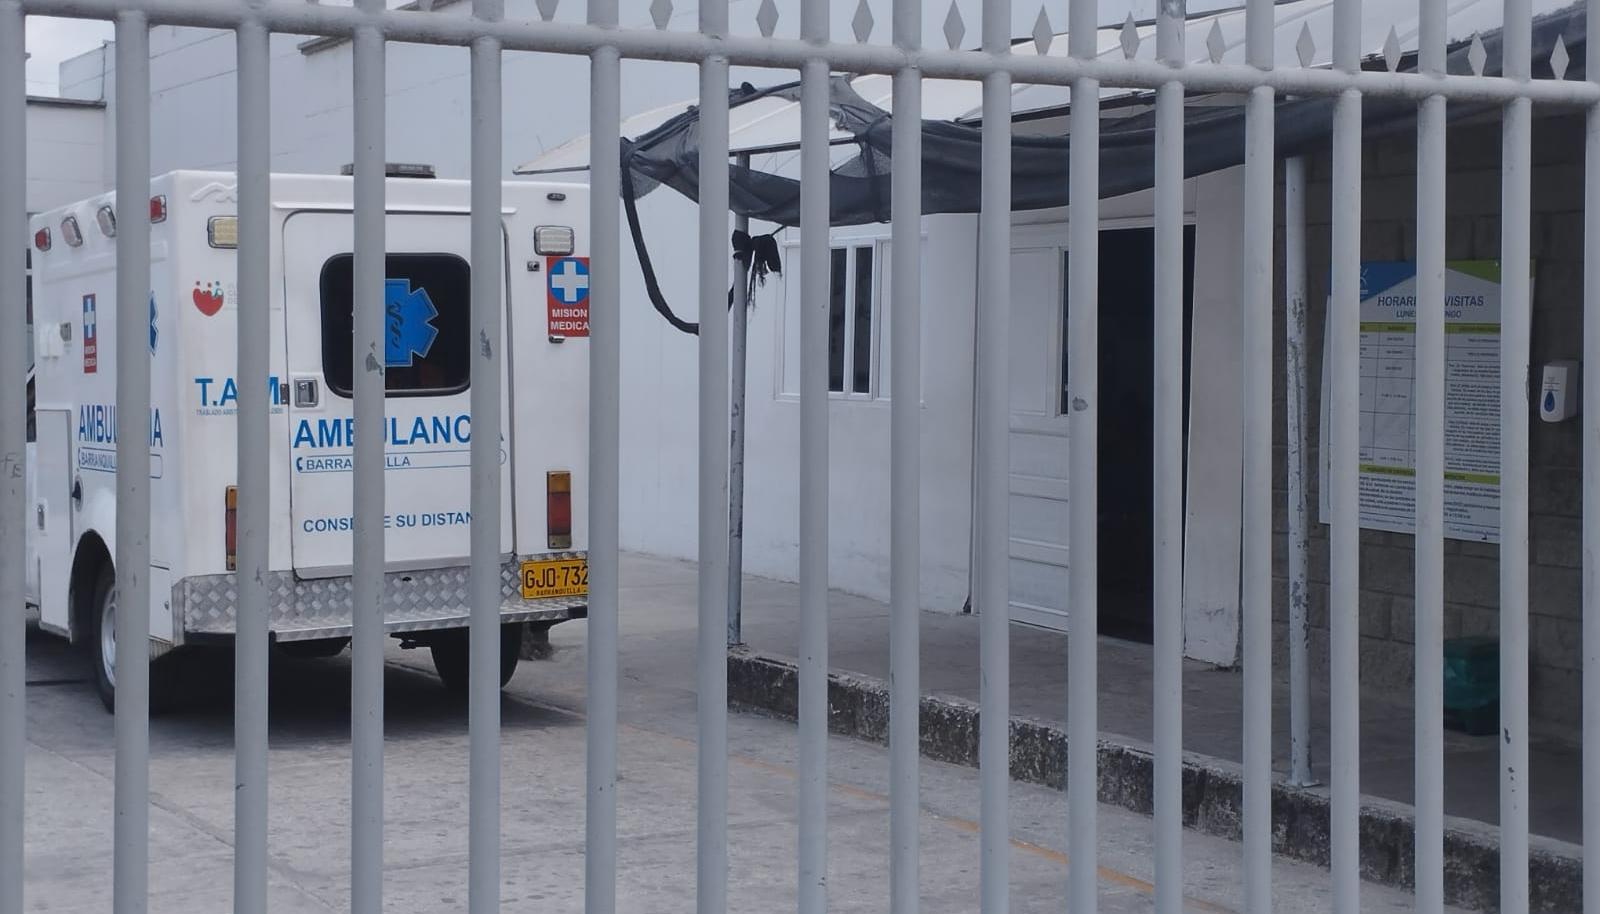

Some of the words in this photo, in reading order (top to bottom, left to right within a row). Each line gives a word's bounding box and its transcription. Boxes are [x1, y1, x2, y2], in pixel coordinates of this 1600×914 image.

[1445, 296, 1484, 306] VISITAS
[551, 308, 588, 318] MISION
[550, 321, 590, 331] MEDICA
[306, 456, 411, 471] BARRALLA
[303, 515, 390, 533] CONSE
[395, 514, 416, 528] SU
